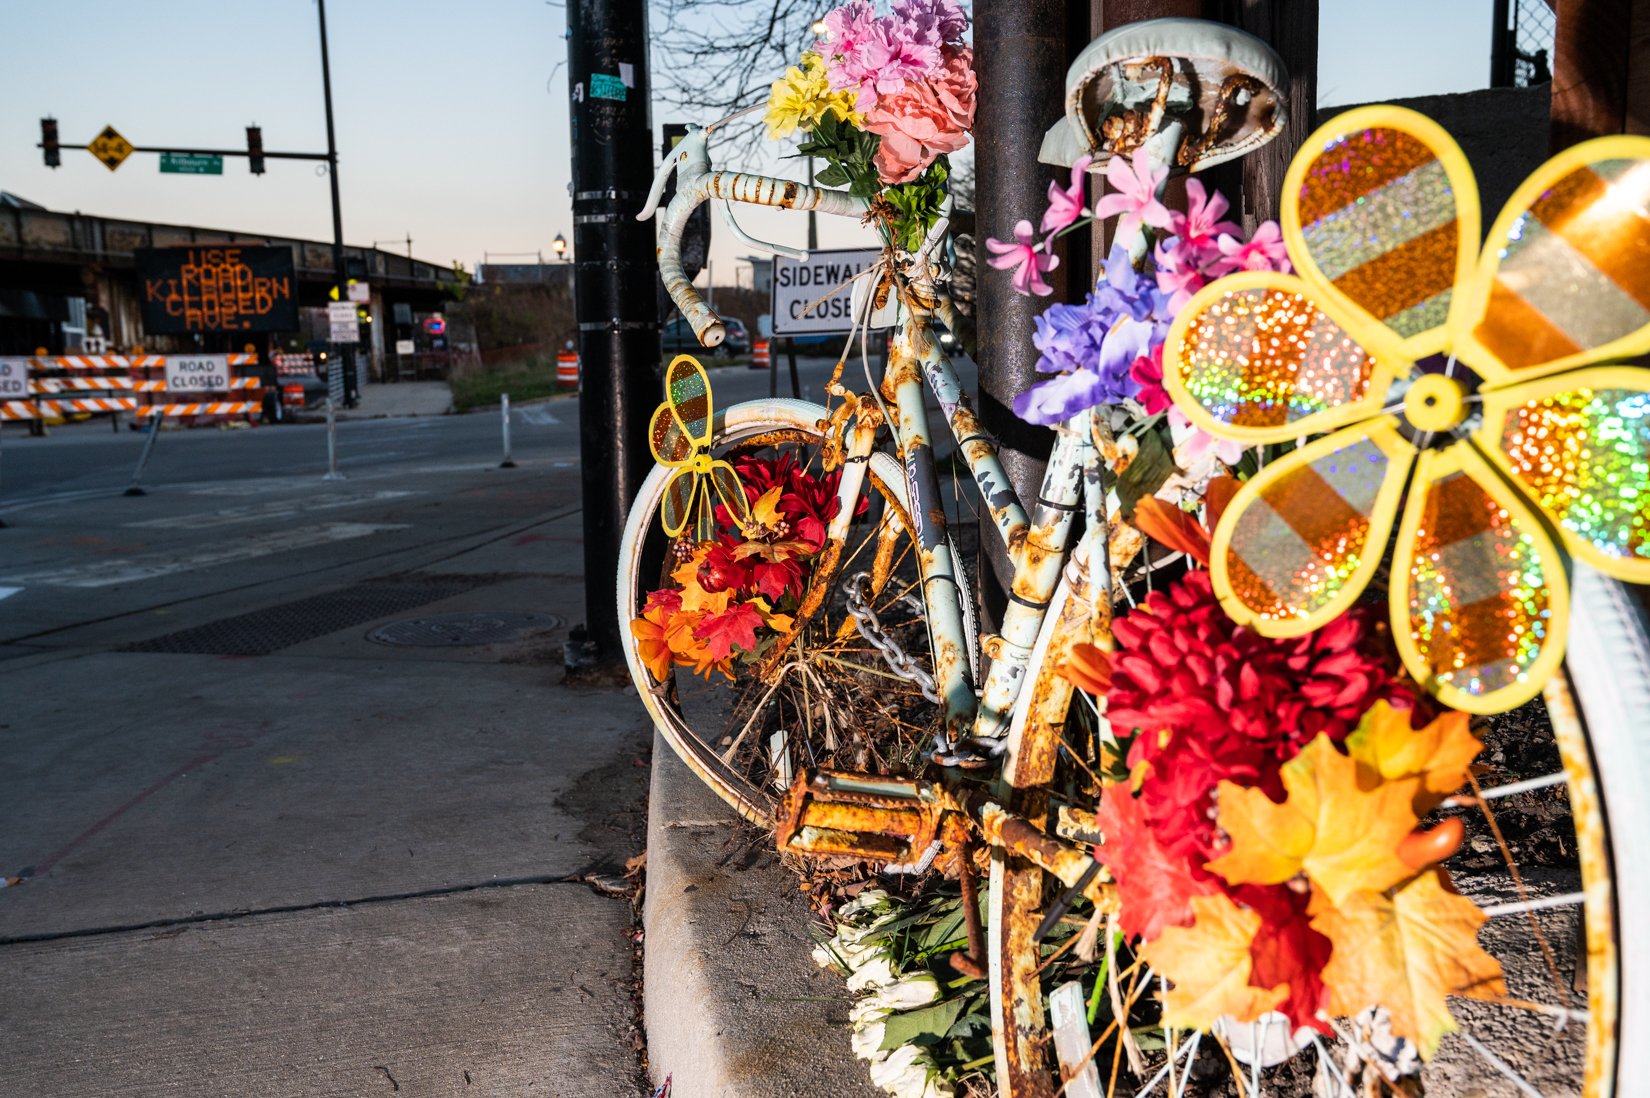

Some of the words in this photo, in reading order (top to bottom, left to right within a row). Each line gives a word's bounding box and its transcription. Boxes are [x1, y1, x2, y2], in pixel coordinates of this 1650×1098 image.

[188, 249, 241, 265] USE
[180, 262, 252, 286] ROAD
[780, 262, 873, 288] SIDEWA
[145, 276, 290, 302] KILBOURN
[165, 291, 273, 317] CLOSED
[789, 297, 852, 320] CLOSE
[185, 308, 252, 331] AVE.
[179, 360, 215, 372] ROAD
[171, 375, 225, 388] CLOSED
